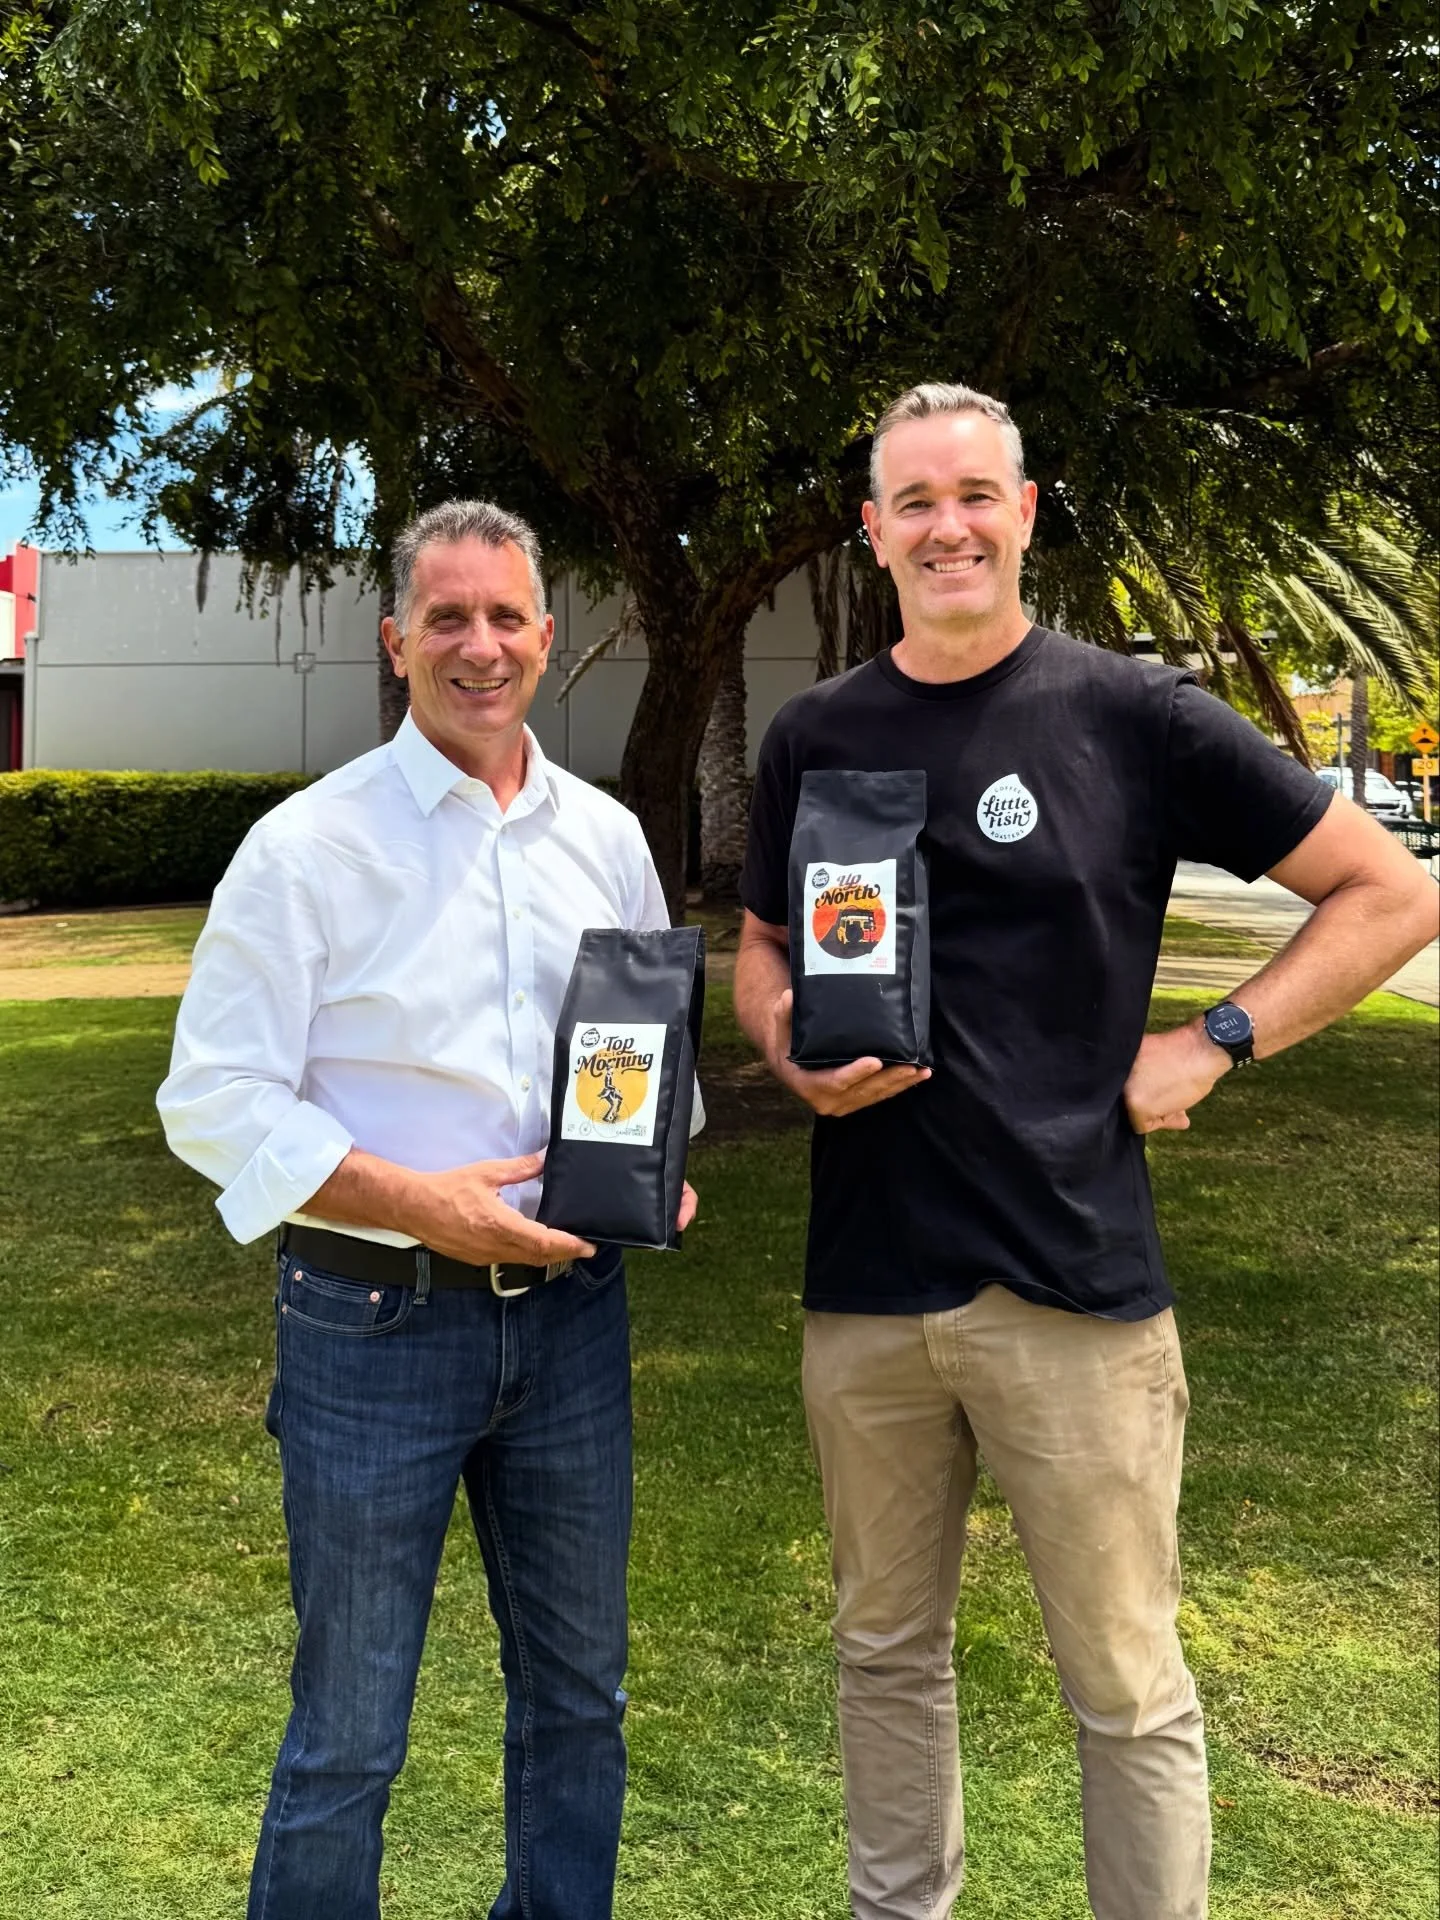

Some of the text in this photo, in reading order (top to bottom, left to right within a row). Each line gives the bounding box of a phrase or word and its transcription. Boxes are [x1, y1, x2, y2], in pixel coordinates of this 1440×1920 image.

[1417, 760, 1434, 770] 20
[994, 786, 1022, 794] COFFEE
[983, 795, 1030, 816] Little
[984, 810, 1031, 828] Fish
[990, 829, 1024, 840] ROASTERS
[836, 872, 862, 891] Up
[815, 883, 881, 909] North
[603, 1036, 636, 1055] Top
[574, 1052, 654, 1078] Morning
